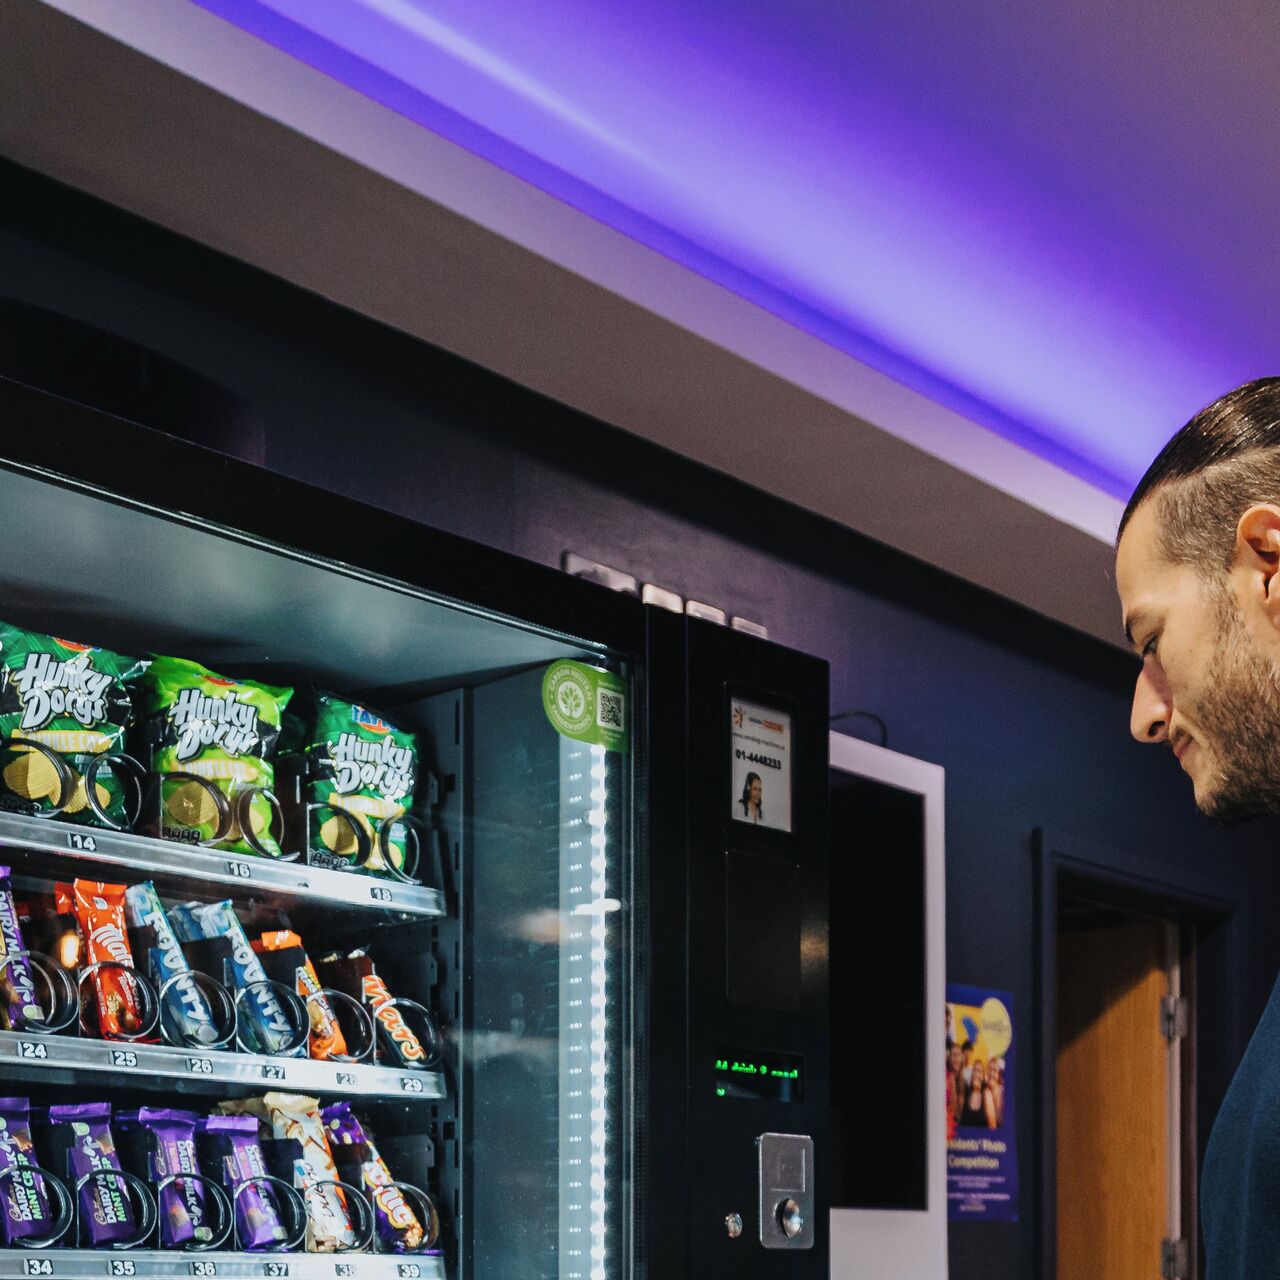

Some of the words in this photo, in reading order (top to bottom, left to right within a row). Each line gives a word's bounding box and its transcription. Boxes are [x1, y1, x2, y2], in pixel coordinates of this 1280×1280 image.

[14, 653, 113, 700] Hunky
[21, 687, 104, 729] Dorys
[170, 689, 257, 733] Hunky
[177, 721, 258, 760] Dorys
[331, 733, 412, 774] Hunky
[336, 760, 411, 799] Dorys
[72, 834, 97, 851] 14
[230, 862, 251, 878] 16
[363, 974, 428, 1061] Mars
[23, 1043, 47, 1058] 24
[114, 1052, 137, 1067] 25
[190, 1058, 213, 1073] 26
[266, 1066, 286, 1080] 27
[403, 1078, 422, 1092] 29
[14, 1181, 33, 1222] DAIRY
[98, 1185, 117, 1224] DAIRY
[28, 1260, 53, 1275] 34
[112, 1261, 136, 1276] 35
[194, 1262, 216, 1276] 36
[268, 1264, 289, 1277] 37
[400, 1265, 420, 1278] 39
